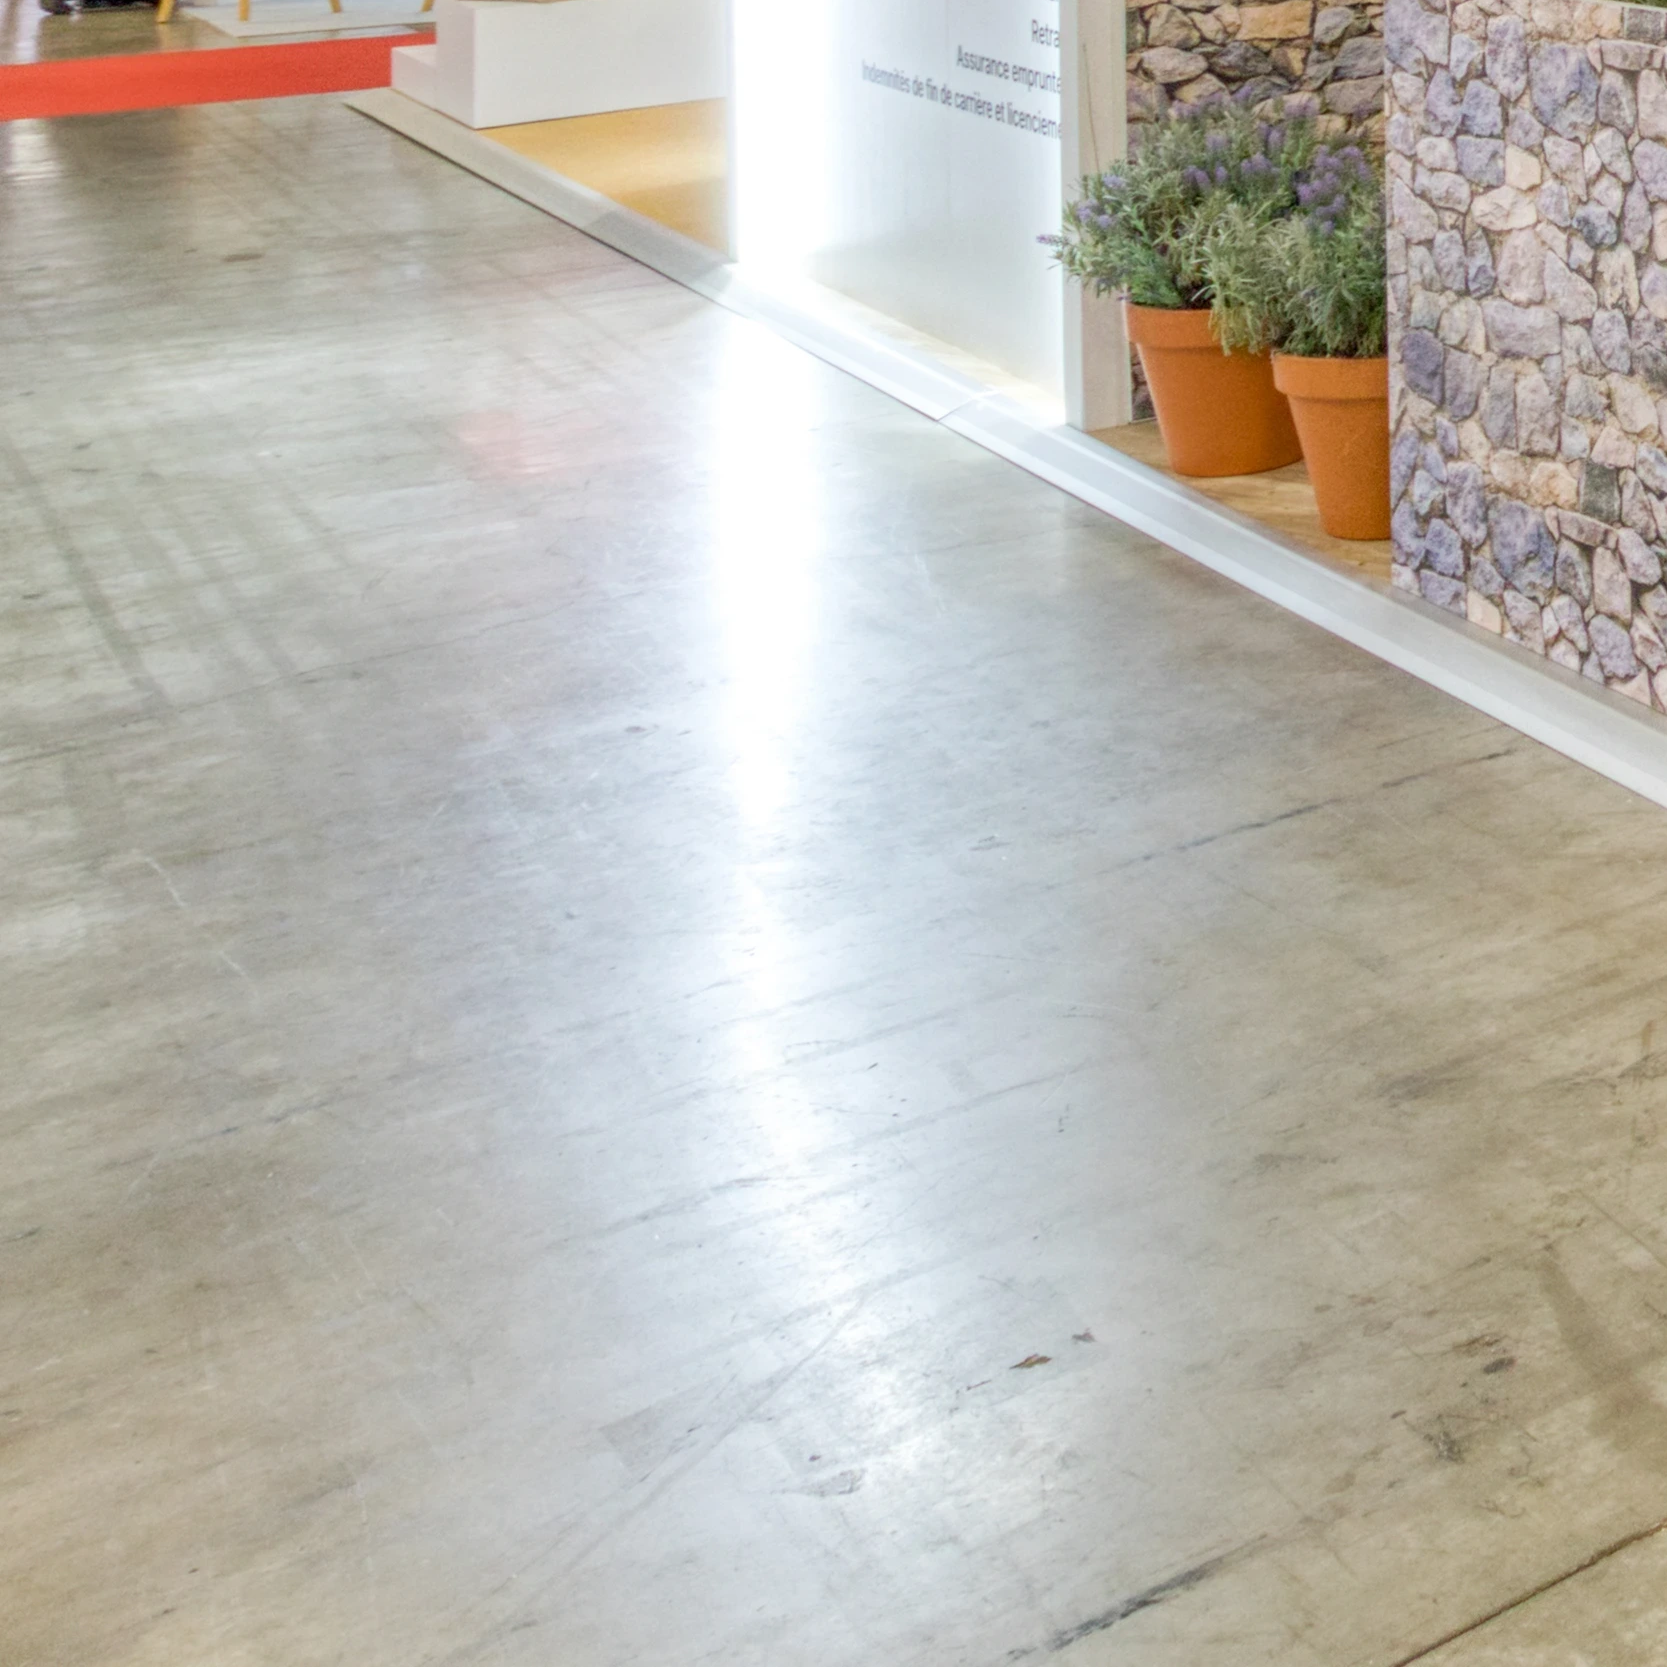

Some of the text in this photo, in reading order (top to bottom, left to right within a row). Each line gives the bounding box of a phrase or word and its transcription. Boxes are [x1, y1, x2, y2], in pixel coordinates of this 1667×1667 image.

[956, 45, 1009, 80] Assurance
[862, 59, 910, 93] Indemnités
[912, 75, 924, 97] de
[926, 78, 938, 102] fin
[940, 84, 952, 106] de
[995, 100, 1005, 123] et
